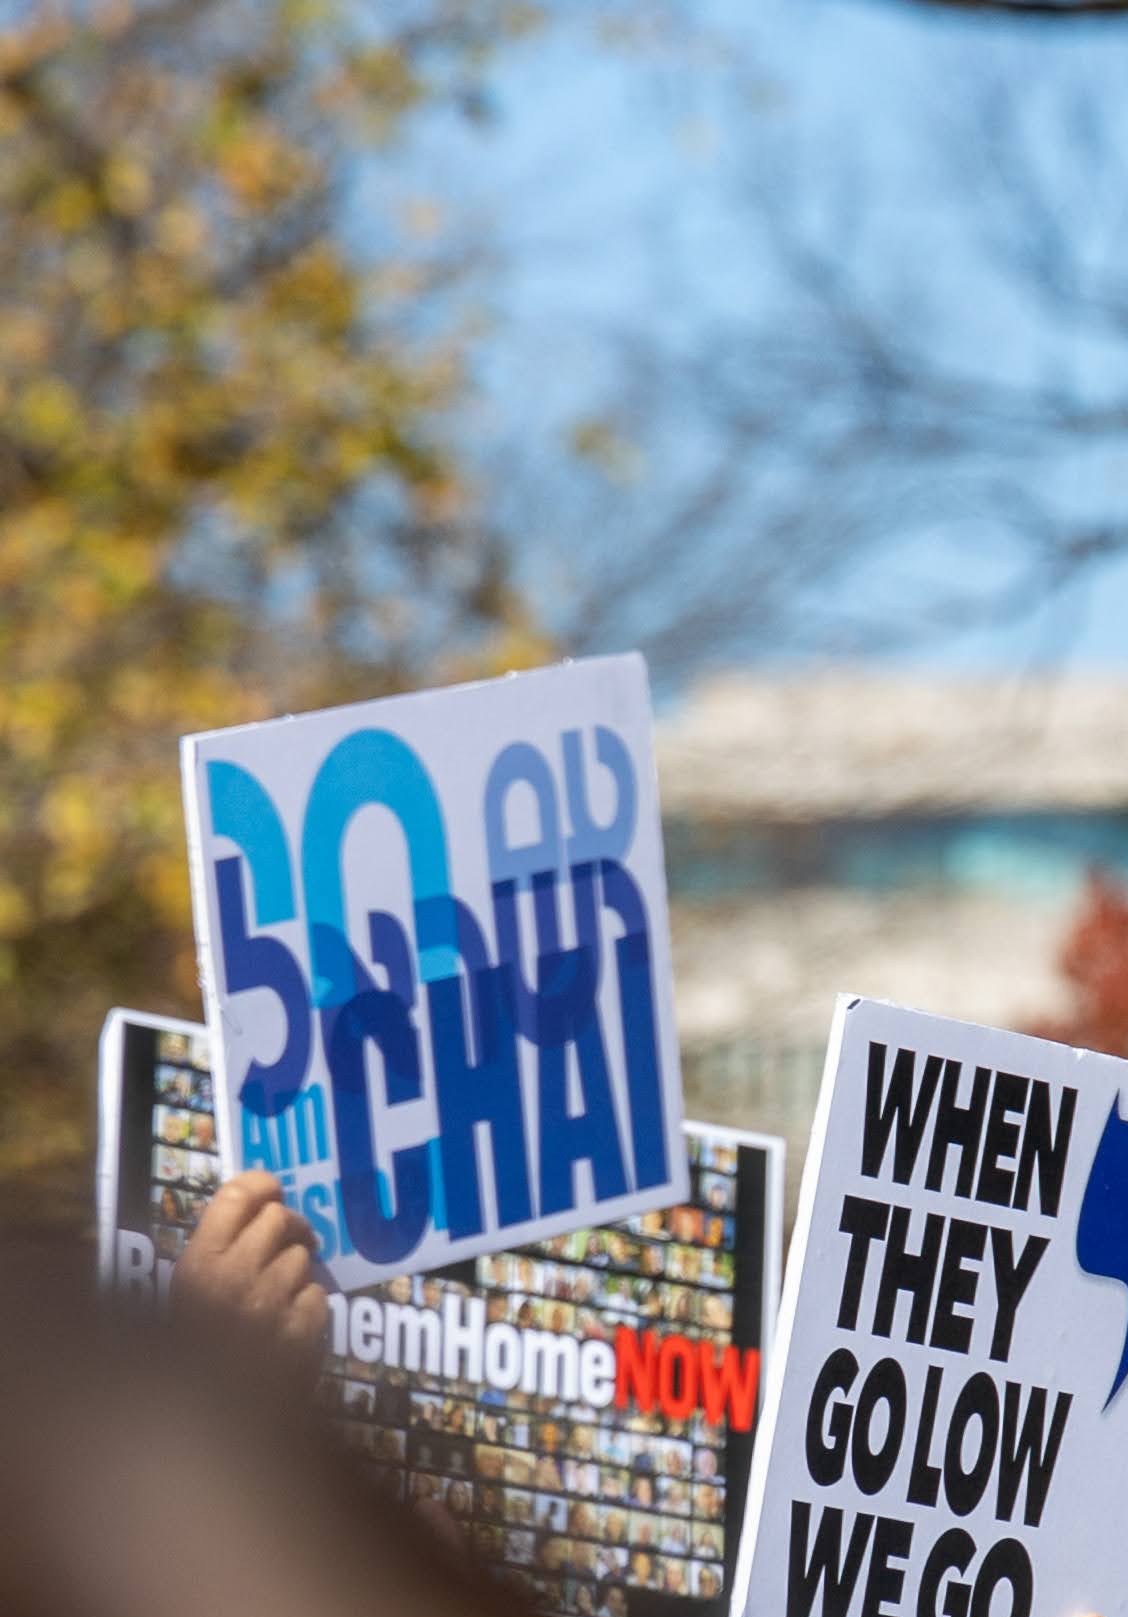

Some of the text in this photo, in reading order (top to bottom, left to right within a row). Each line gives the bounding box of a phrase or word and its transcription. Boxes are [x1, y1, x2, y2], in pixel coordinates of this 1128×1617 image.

[329, 931, 673, 1265] CHAI
[861, 1041, 1078, 1218] WHEN
[837, 1195, 1051, 1363] THEY
[805, 1347, 1074, 1528] GO LOW
